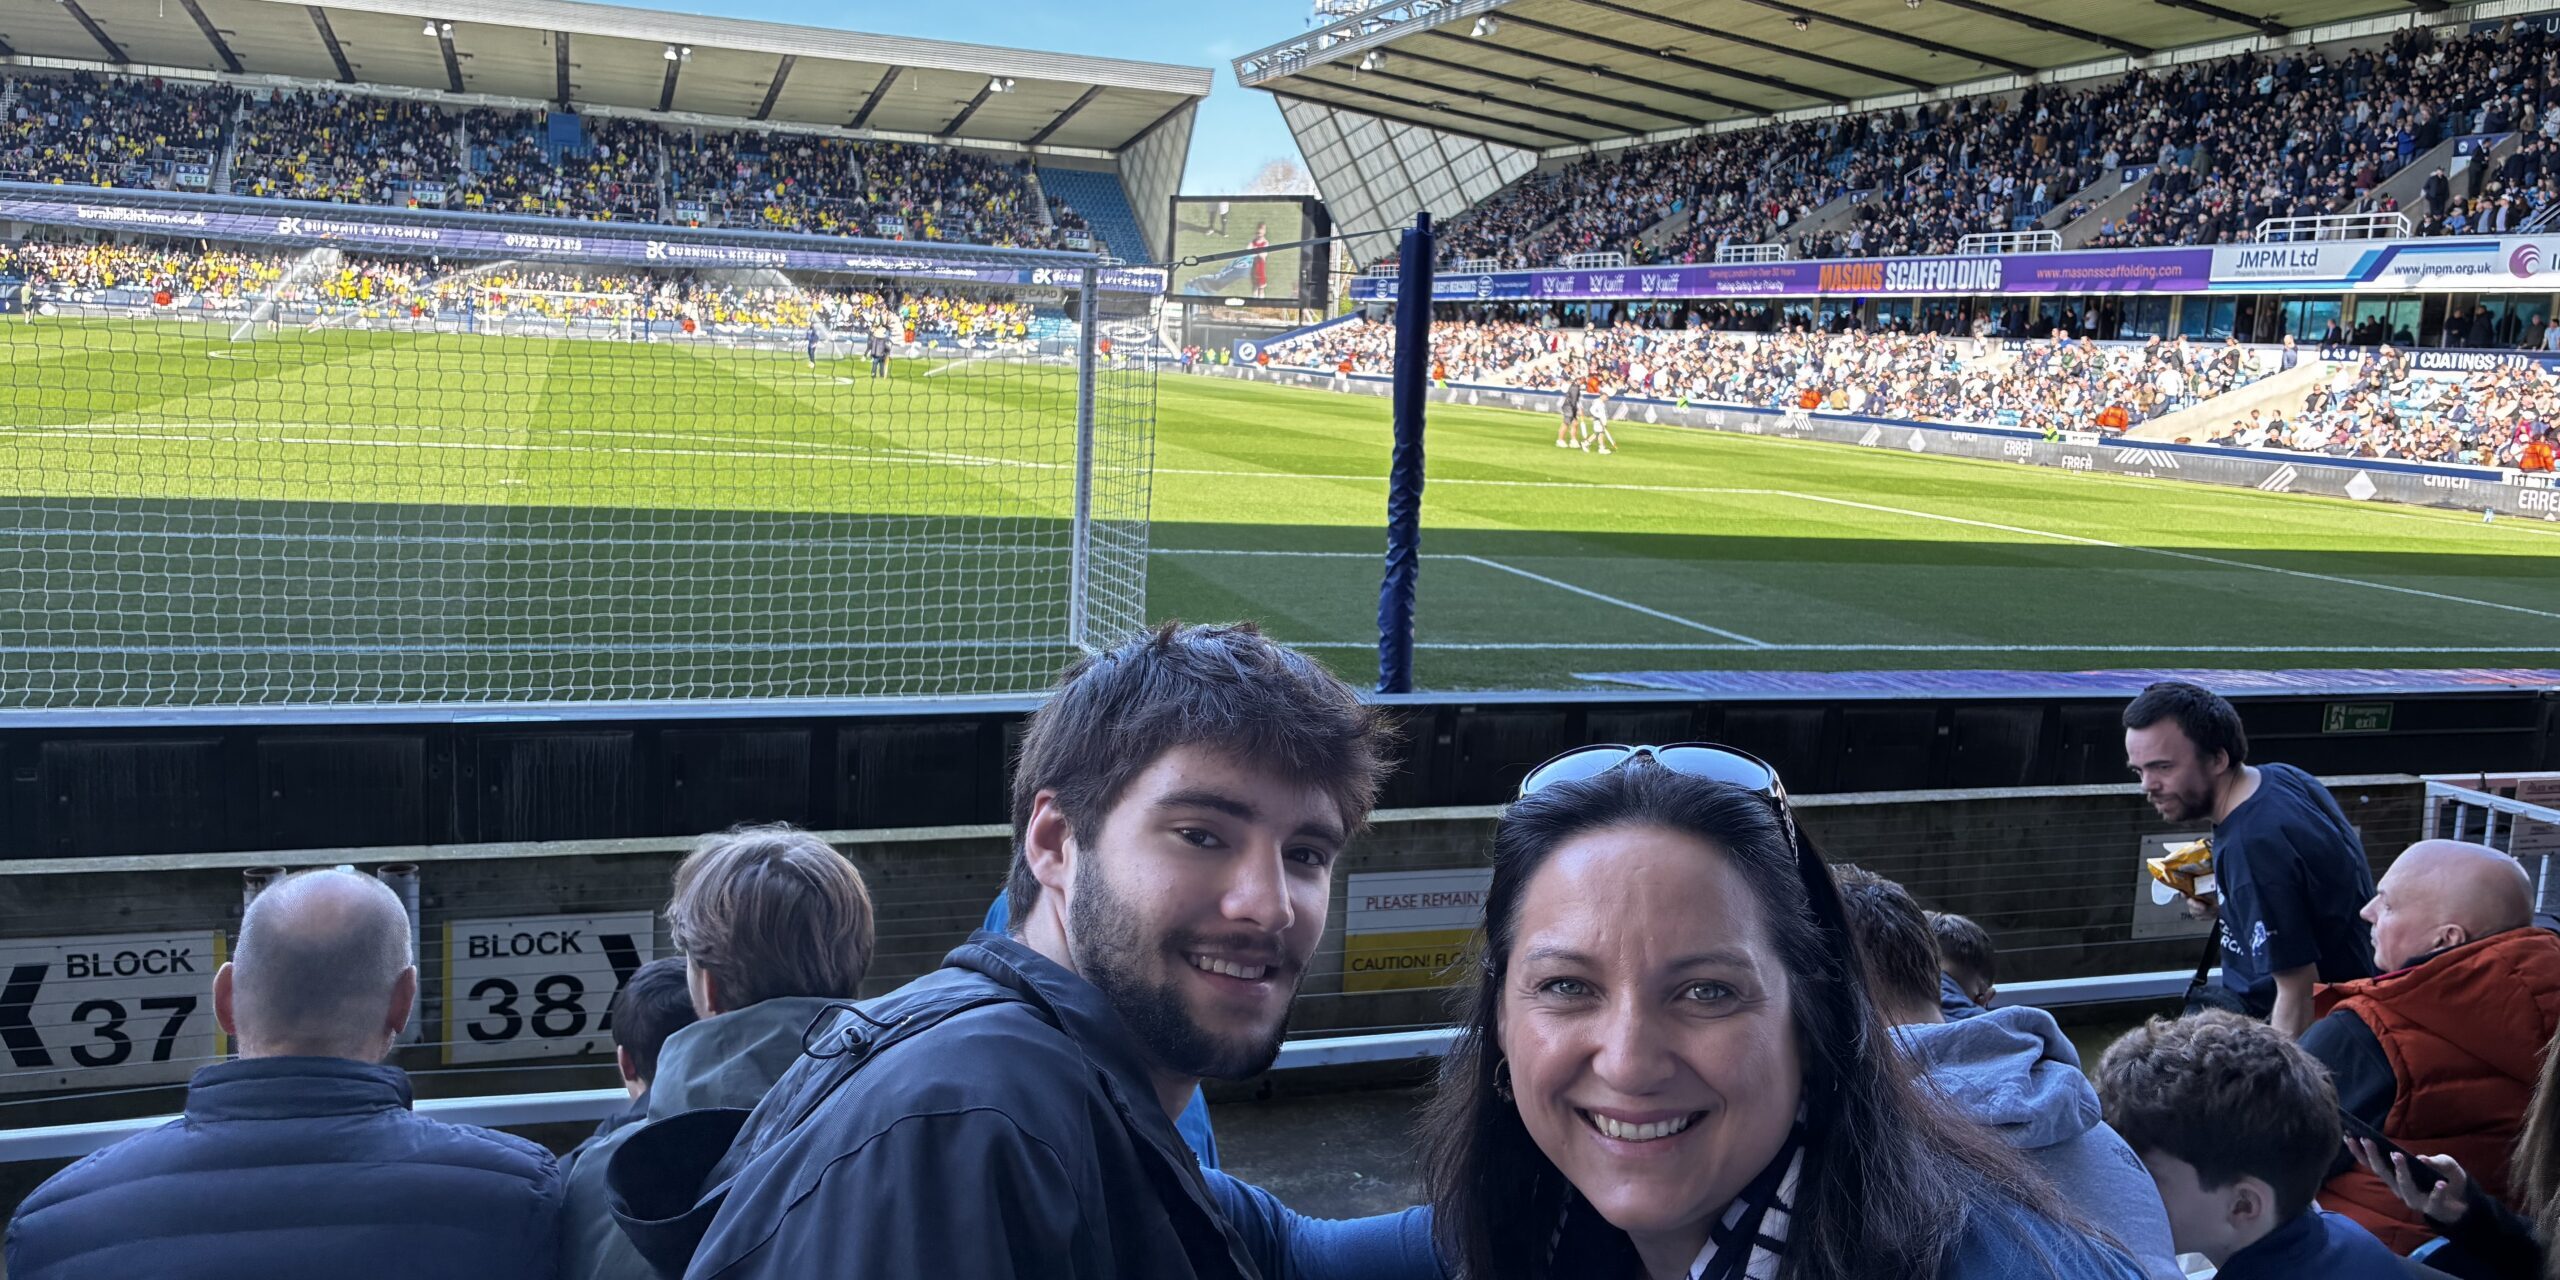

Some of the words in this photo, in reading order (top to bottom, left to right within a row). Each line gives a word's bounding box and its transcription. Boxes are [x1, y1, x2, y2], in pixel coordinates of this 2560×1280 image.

[668, 246, 726, 259] BURNHILL
[728, 251, 787, 262] KITCHENS
[2236, 250, 2286, 268] JMPM
[2290, 248, 2319, 267] Ltd
[1818, 263, 1883, 291] MASONS
[1885, 259, 2002, 291] SCAFFOLDING
[2037, 264, 2182, 280] www.masonsscaffolding.com
[2394, 262, 2491, 276] www.jmpm.org.uk
[1028, 287, 1058, 299] CARD
[2332, 349, 2345, 359] 43
[2420, 351, 2496, 370] COATINGS
[2355, 717, 2376, 728] exit
[1366, 894, 1418, 911] PLEASE
[1422, 892, 1480, 907] REMAIN
[469, 930, 583, 959] BLOCK
[67, 948, 194, 978] BLOCK
[1352, 954, 1430, 972] CAUTION!
[467, 975, 587, 1044] 38
[70, 996, 197, 1067] 37
